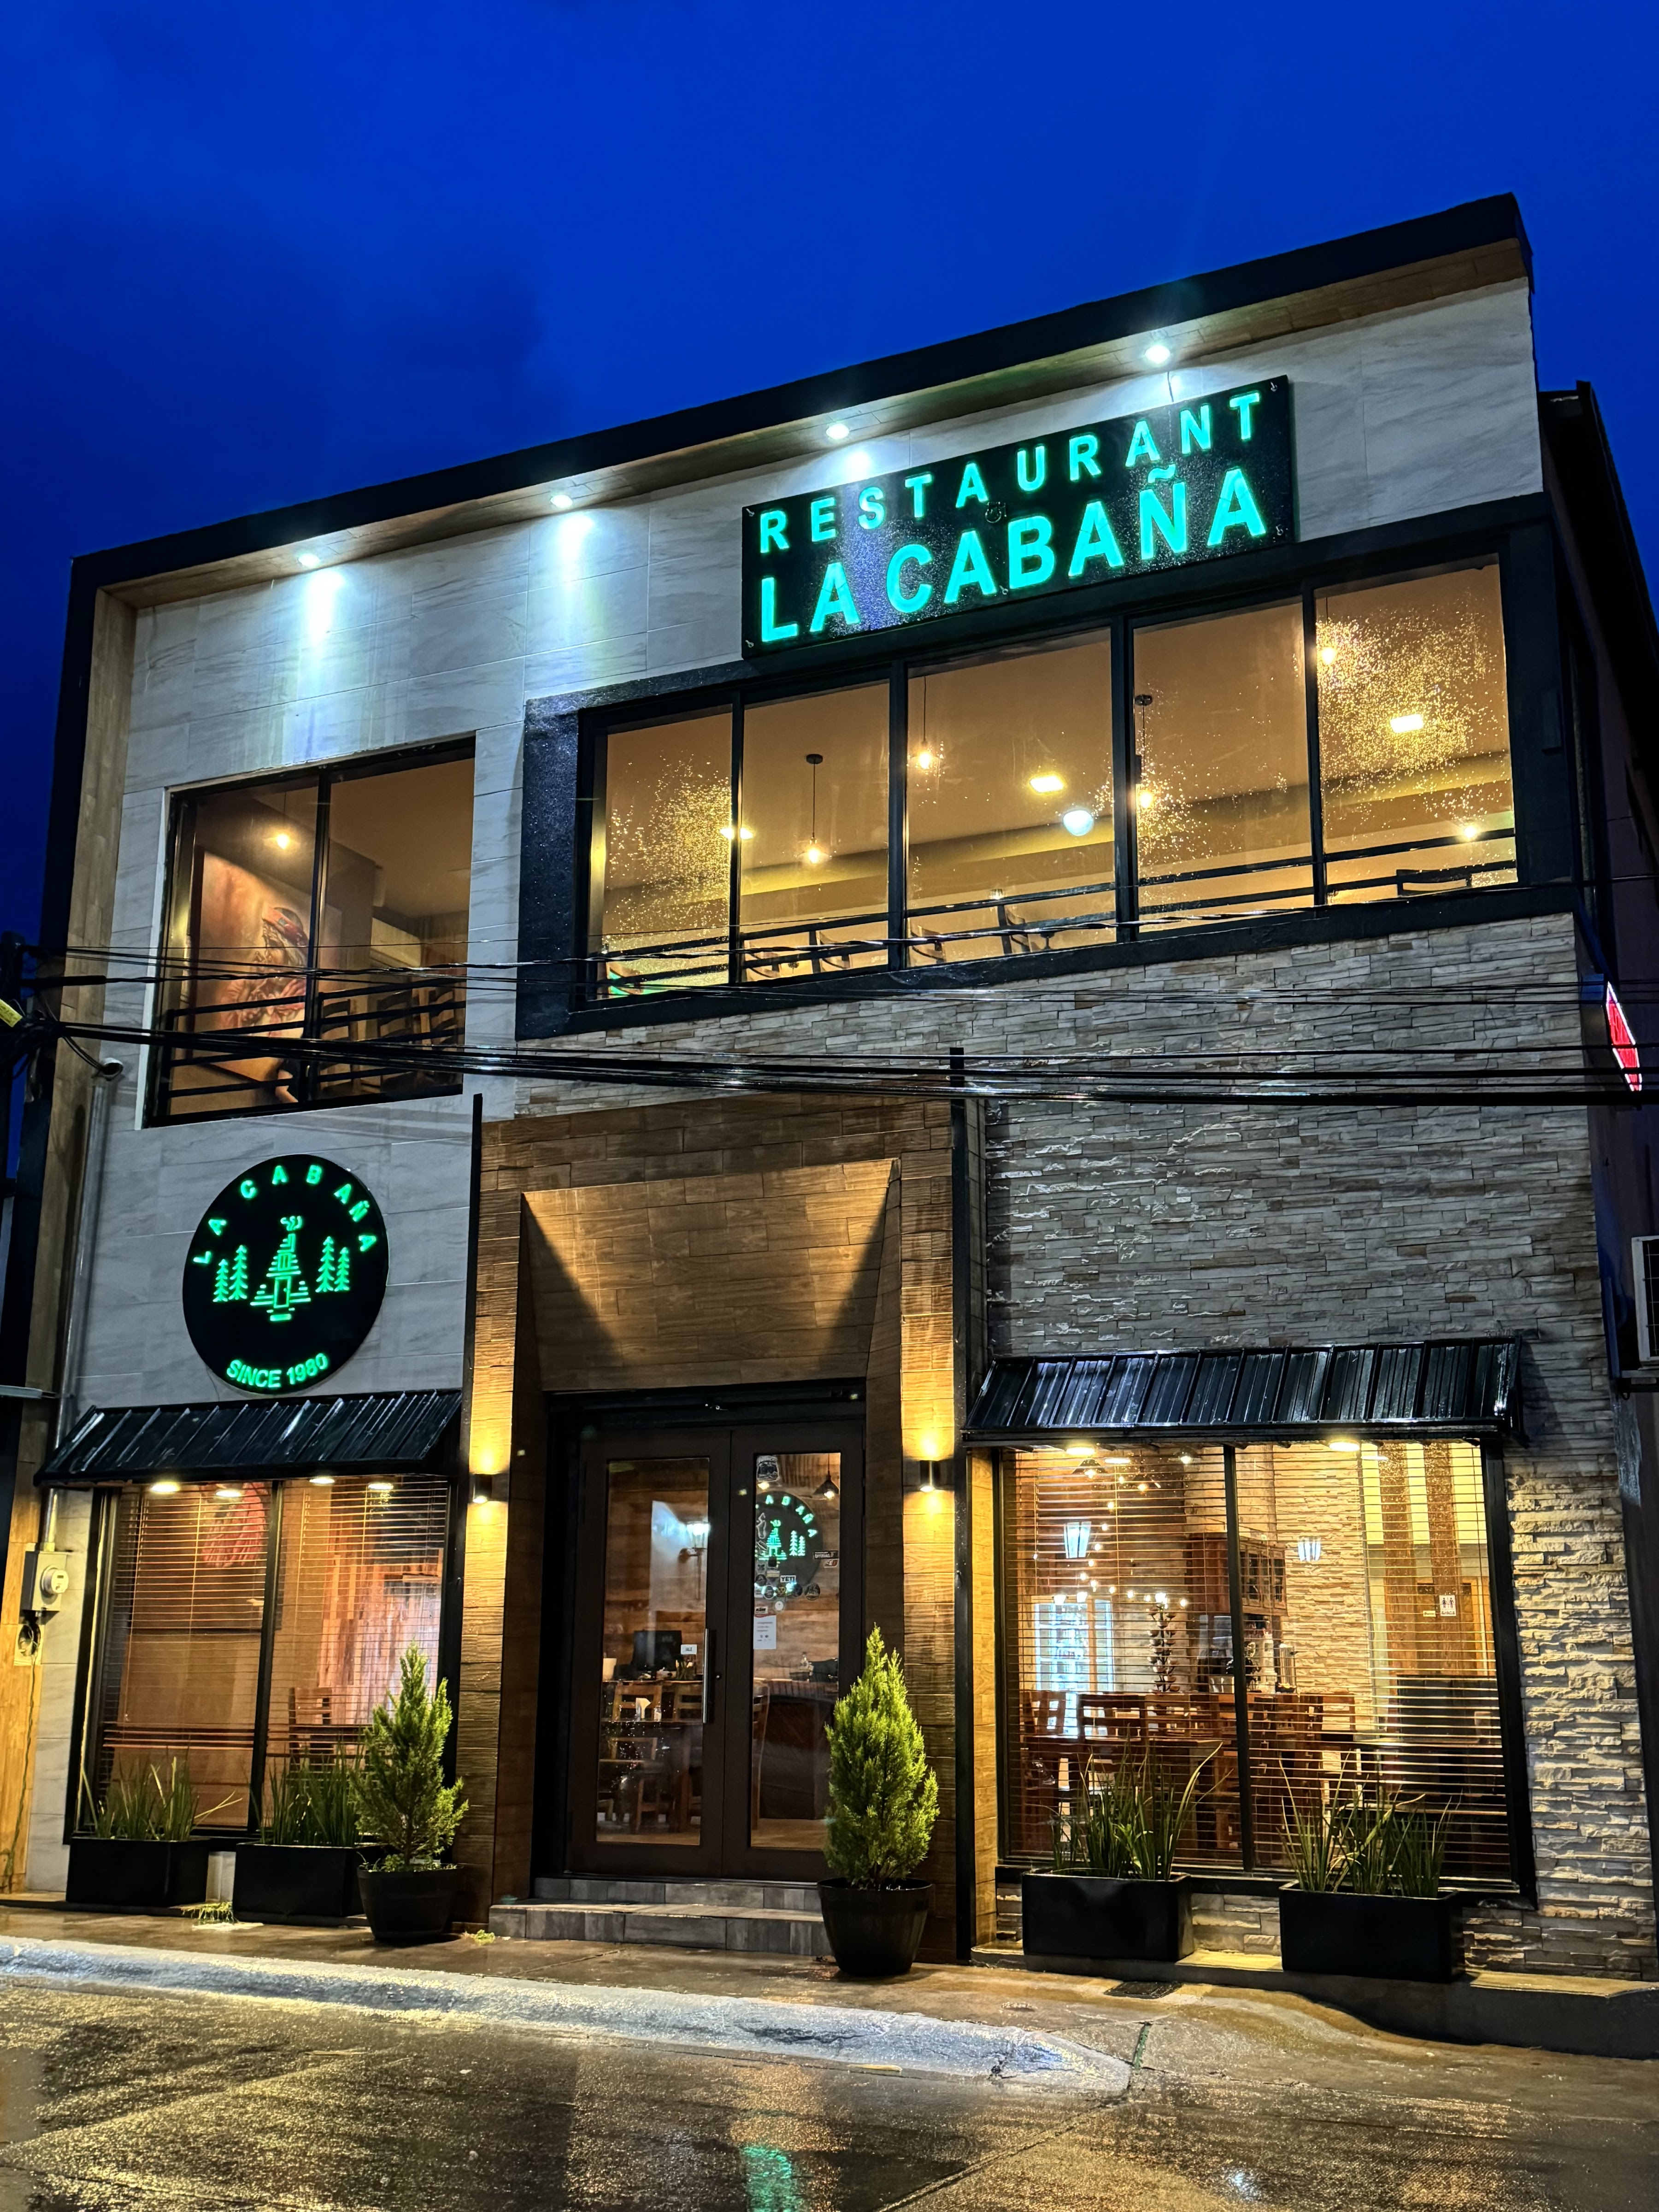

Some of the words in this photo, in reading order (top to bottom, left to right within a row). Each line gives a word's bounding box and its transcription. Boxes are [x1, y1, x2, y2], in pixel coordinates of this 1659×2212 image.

[759, 391, 1261, 554] RESTAURANT
[760, 559, 864, 643] LA
[885, 460, 1267, 617] CABAÑA
[192, 1218, 228, 1265] LA
[239, 1164, 377, 1253] CABAÑA
[226, 1359, 283, 1389] SINCE
[285, 1352, 329, 1385] 1980
[755, 1494, 818, 1538] ABAÑA
